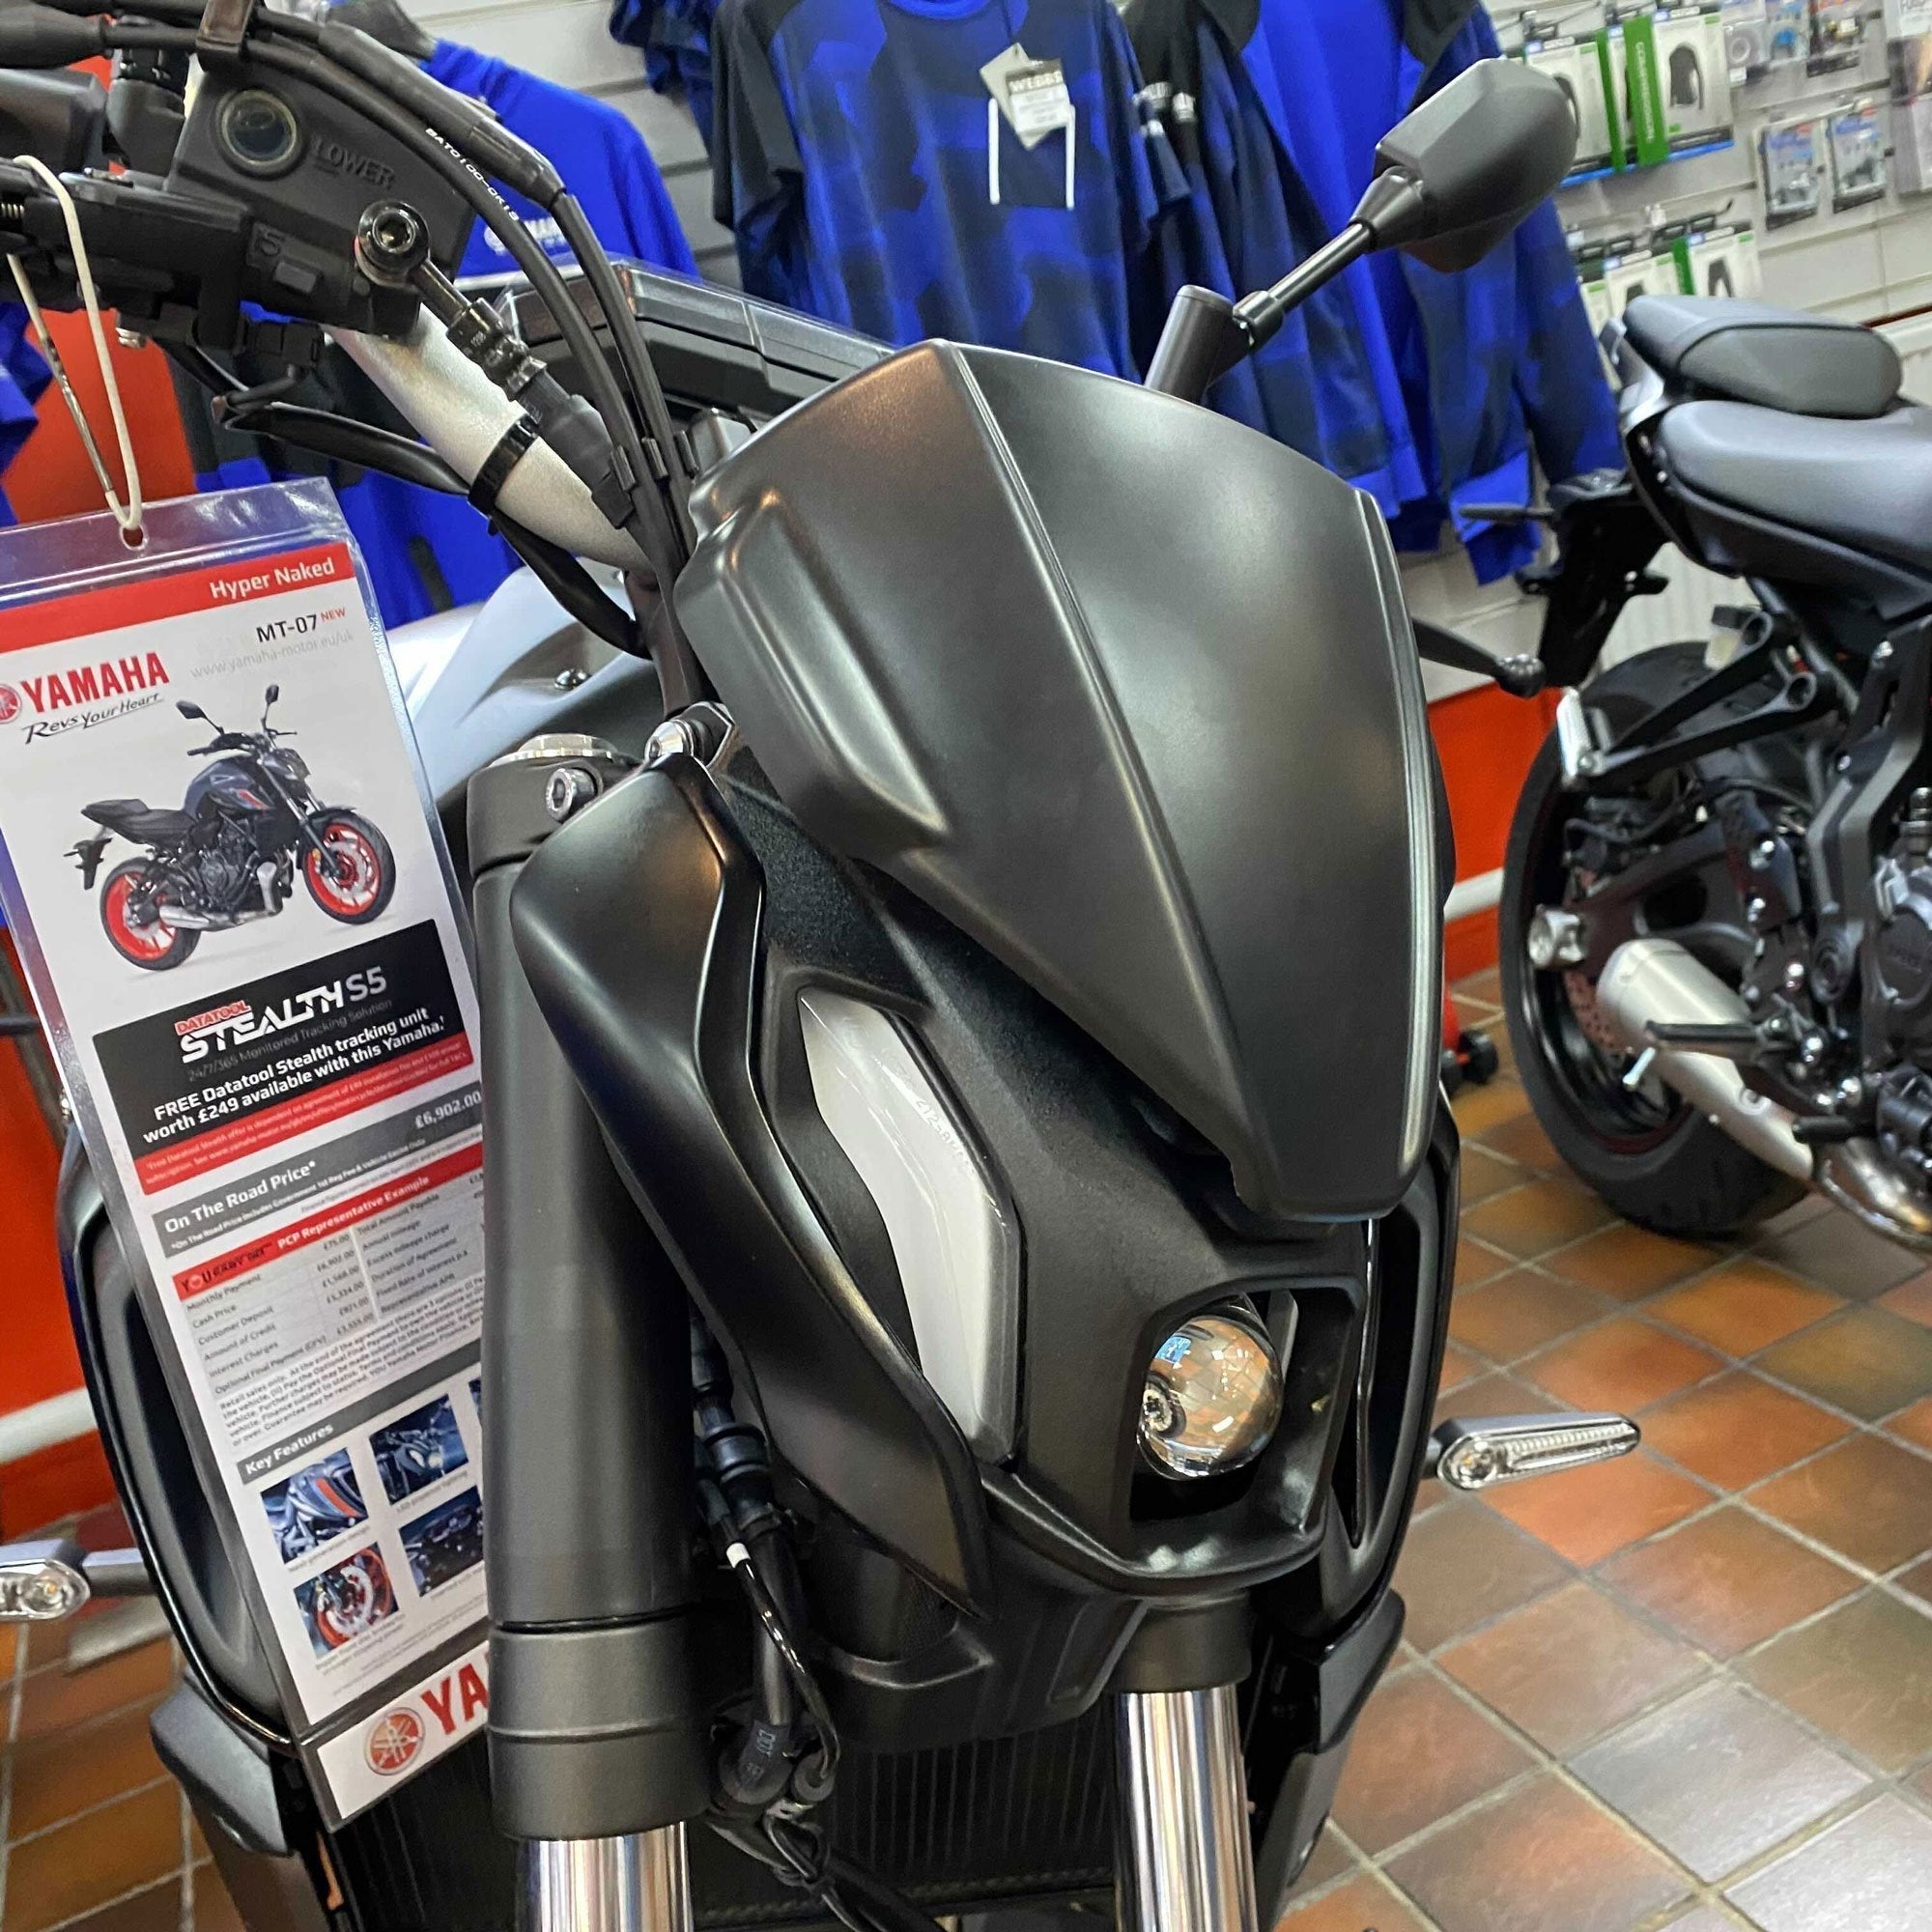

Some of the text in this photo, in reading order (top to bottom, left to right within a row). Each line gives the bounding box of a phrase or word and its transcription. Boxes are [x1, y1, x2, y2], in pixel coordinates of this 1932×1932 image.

[312, 137, 397, 190] LOWER
[210, 557, 335, 600] Hyper Naked
[256, 607, 346, 642] MT-07 NEW
[20, 651, 170, 713] YAMAHA
[22, 693, 159, 745] Revs Your Heart
[174, 997, 251, 1037] DATATOOL
[176, 965, 388, 1064] STEALTH S5
[298, 1012, 348, 1040] Tracking
[347, 996, 393, 1023] Solution
[154, 1006, 429, 1121] FREE Datatool Stealth tracking unit
[141, 1112, 196, 1145] worth
[195, 1094, 240, 1123] £249
[240, 1067, 312, 1107] available
[313, 1053, 350, 1079] with
[350, 1040, 381, 1065] this
[413, 1090, 483, 1129] £6,902.00
[163, 1212, 190, 1233] On
[190, 1198, 224, 1222] The
[225, 1180, 269, 1208] Road
[276, 1232, 300, 1249] PCP
[300, 1195, 384, 1240] Representative
[383, 1173, 430, 1204] Example
[223, 1273, 261, 1296] Payment
[191, 1303, 237, 1328] Cash Price
[197, 1321, 240, 1346] Customer
[203, 1340, 238, 1361] Amount
[249, 1322, 275, 1340] Credit
[243, 1340, 278, 1362] Charges
[244, 1421, 334, 1476] Key Features
